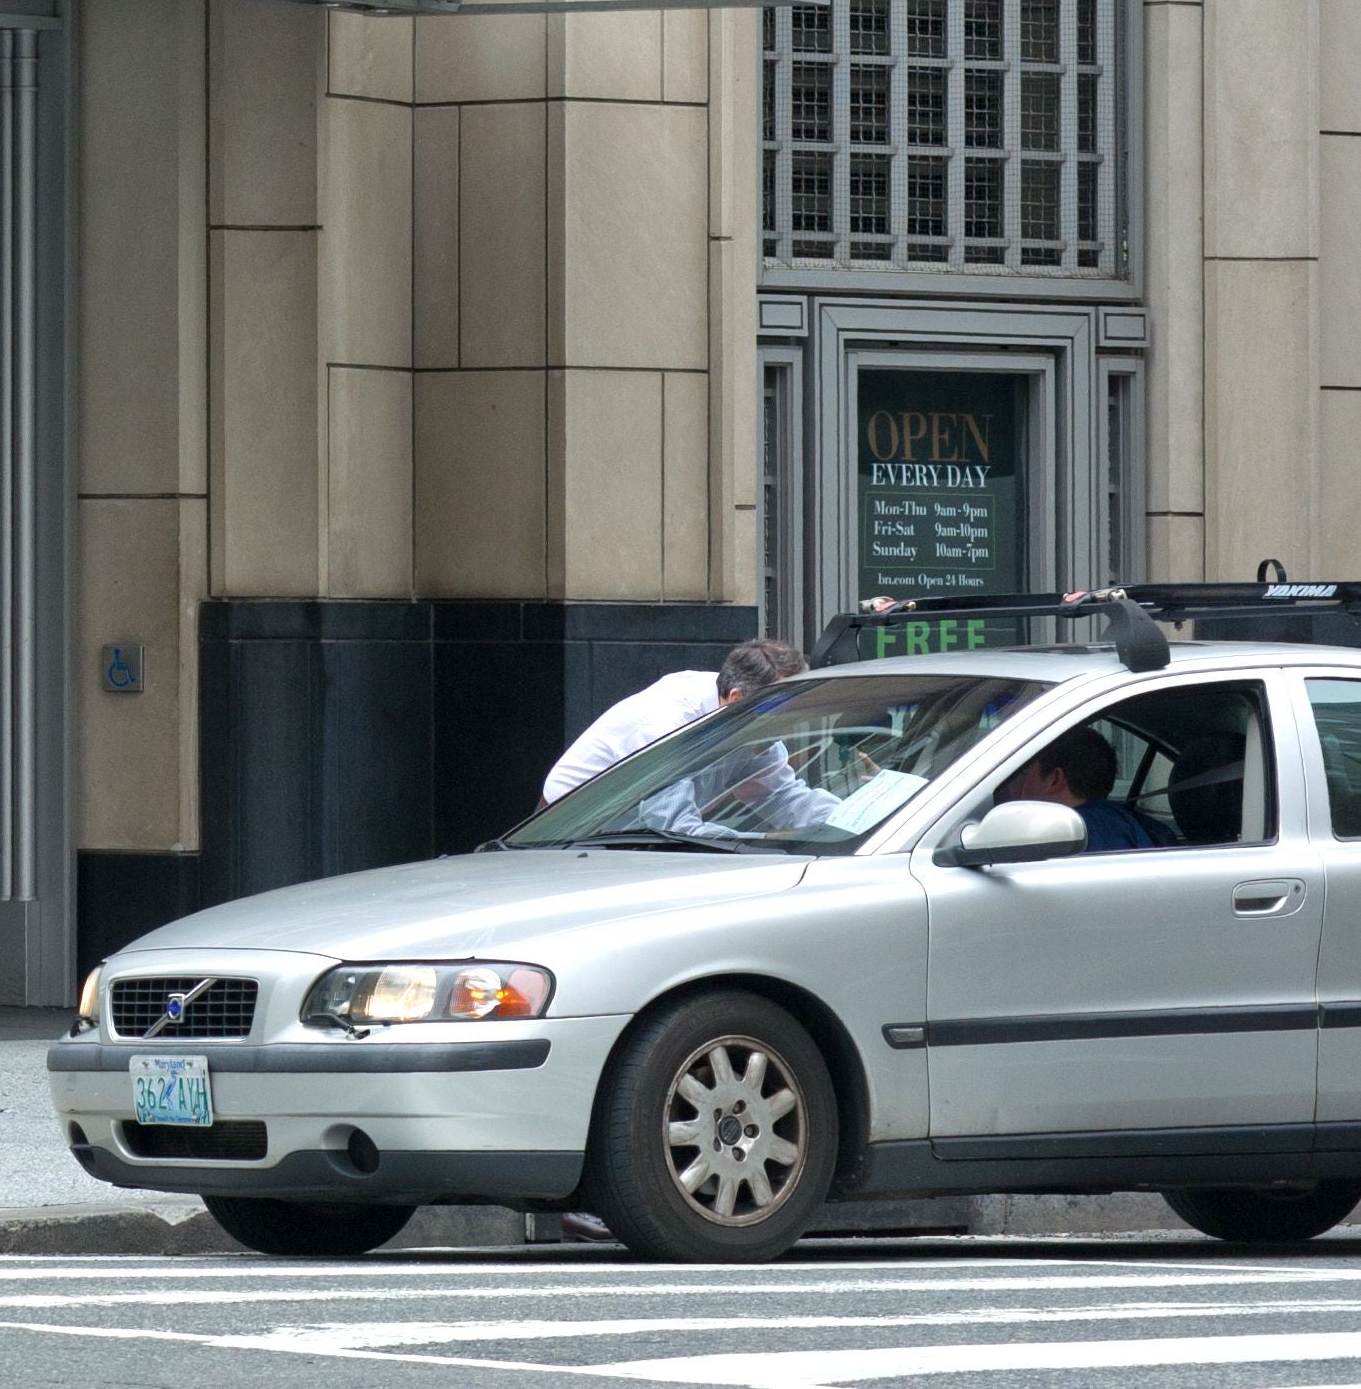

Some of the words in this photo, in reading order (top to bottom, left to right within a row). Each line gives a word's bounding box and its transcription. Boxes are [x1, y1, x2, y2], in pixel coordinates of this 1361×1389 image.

[868, 410, 995, 462] OPEN
[871, 463, 944, 487] EVERY
[947, 466, 991, 488] DAY
[874, 500, 927, 515] Mon-Thu
[874, 521, 915, 536] Fri-Sat
[934, 523, 988, 542] 9am-10pm
[873, 541, 918, 561] Sunday
[935, 543, 989, 562] 10am-7pm
[878, 573, 915, 586] bn.com
[918, 573, 943, 589] Open
[946, 574, 956, 586] 24
[959, 575, 984, 587] Hours
[1264, 585, 1337, 597] YAKIMA
[155, 1059, 186, 1071] Maryland
[137, 1077, 167, 1110] 362
